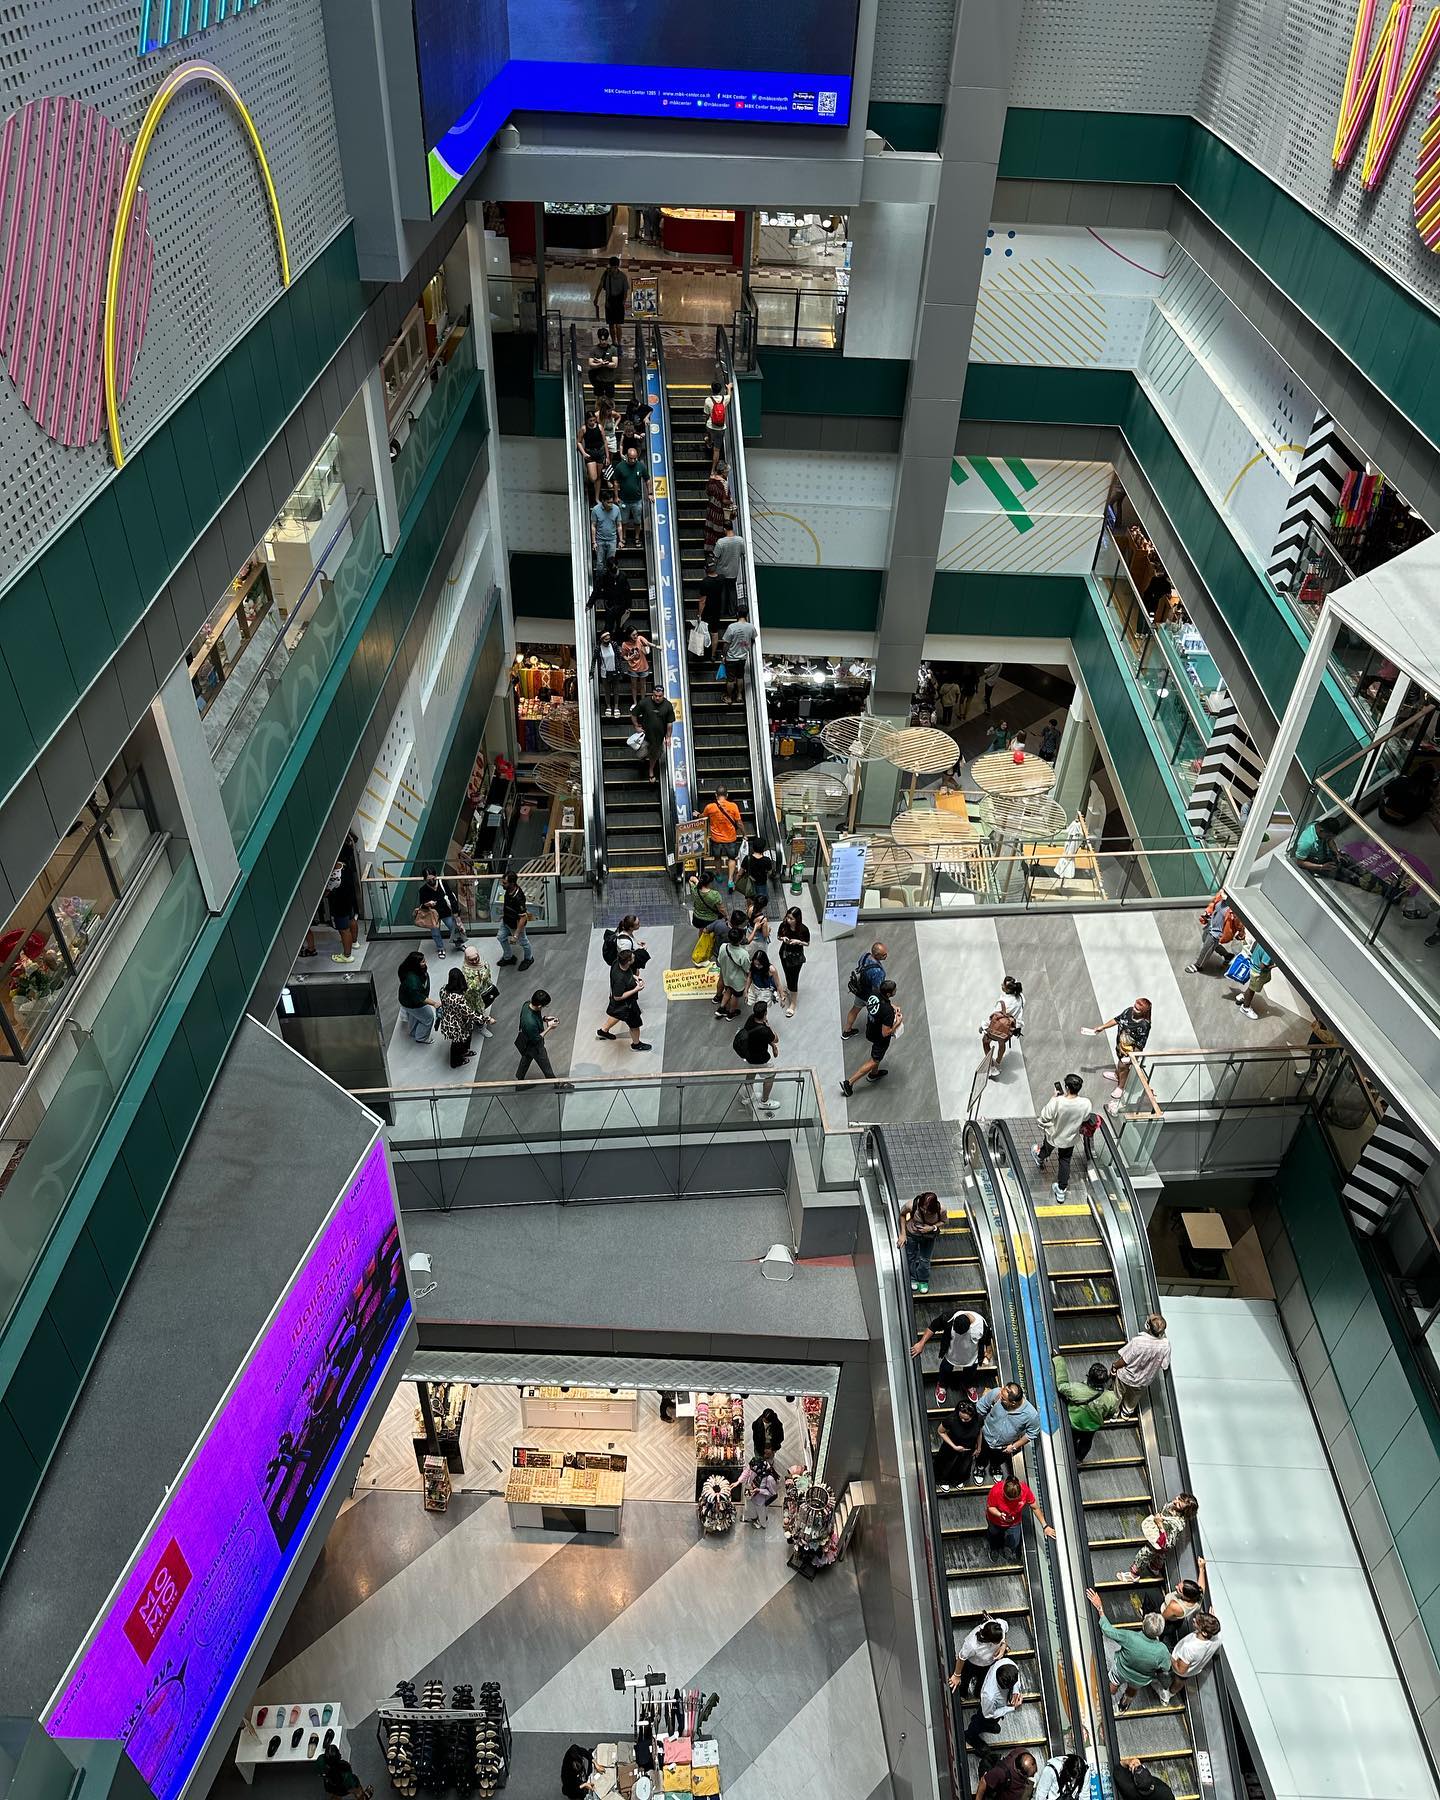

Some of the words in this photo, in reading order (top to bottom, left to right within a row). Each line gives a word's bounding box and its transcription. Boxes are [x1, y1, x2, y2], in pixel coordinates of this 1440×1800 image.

[679, 820, 705, 831] CAUTION
[857, 848, 865, 857] 2
[681, 973, 706, 982] CENTER
[139, 1568, 168, 1620] MO
[146, 1580, 176, 1634] MO
